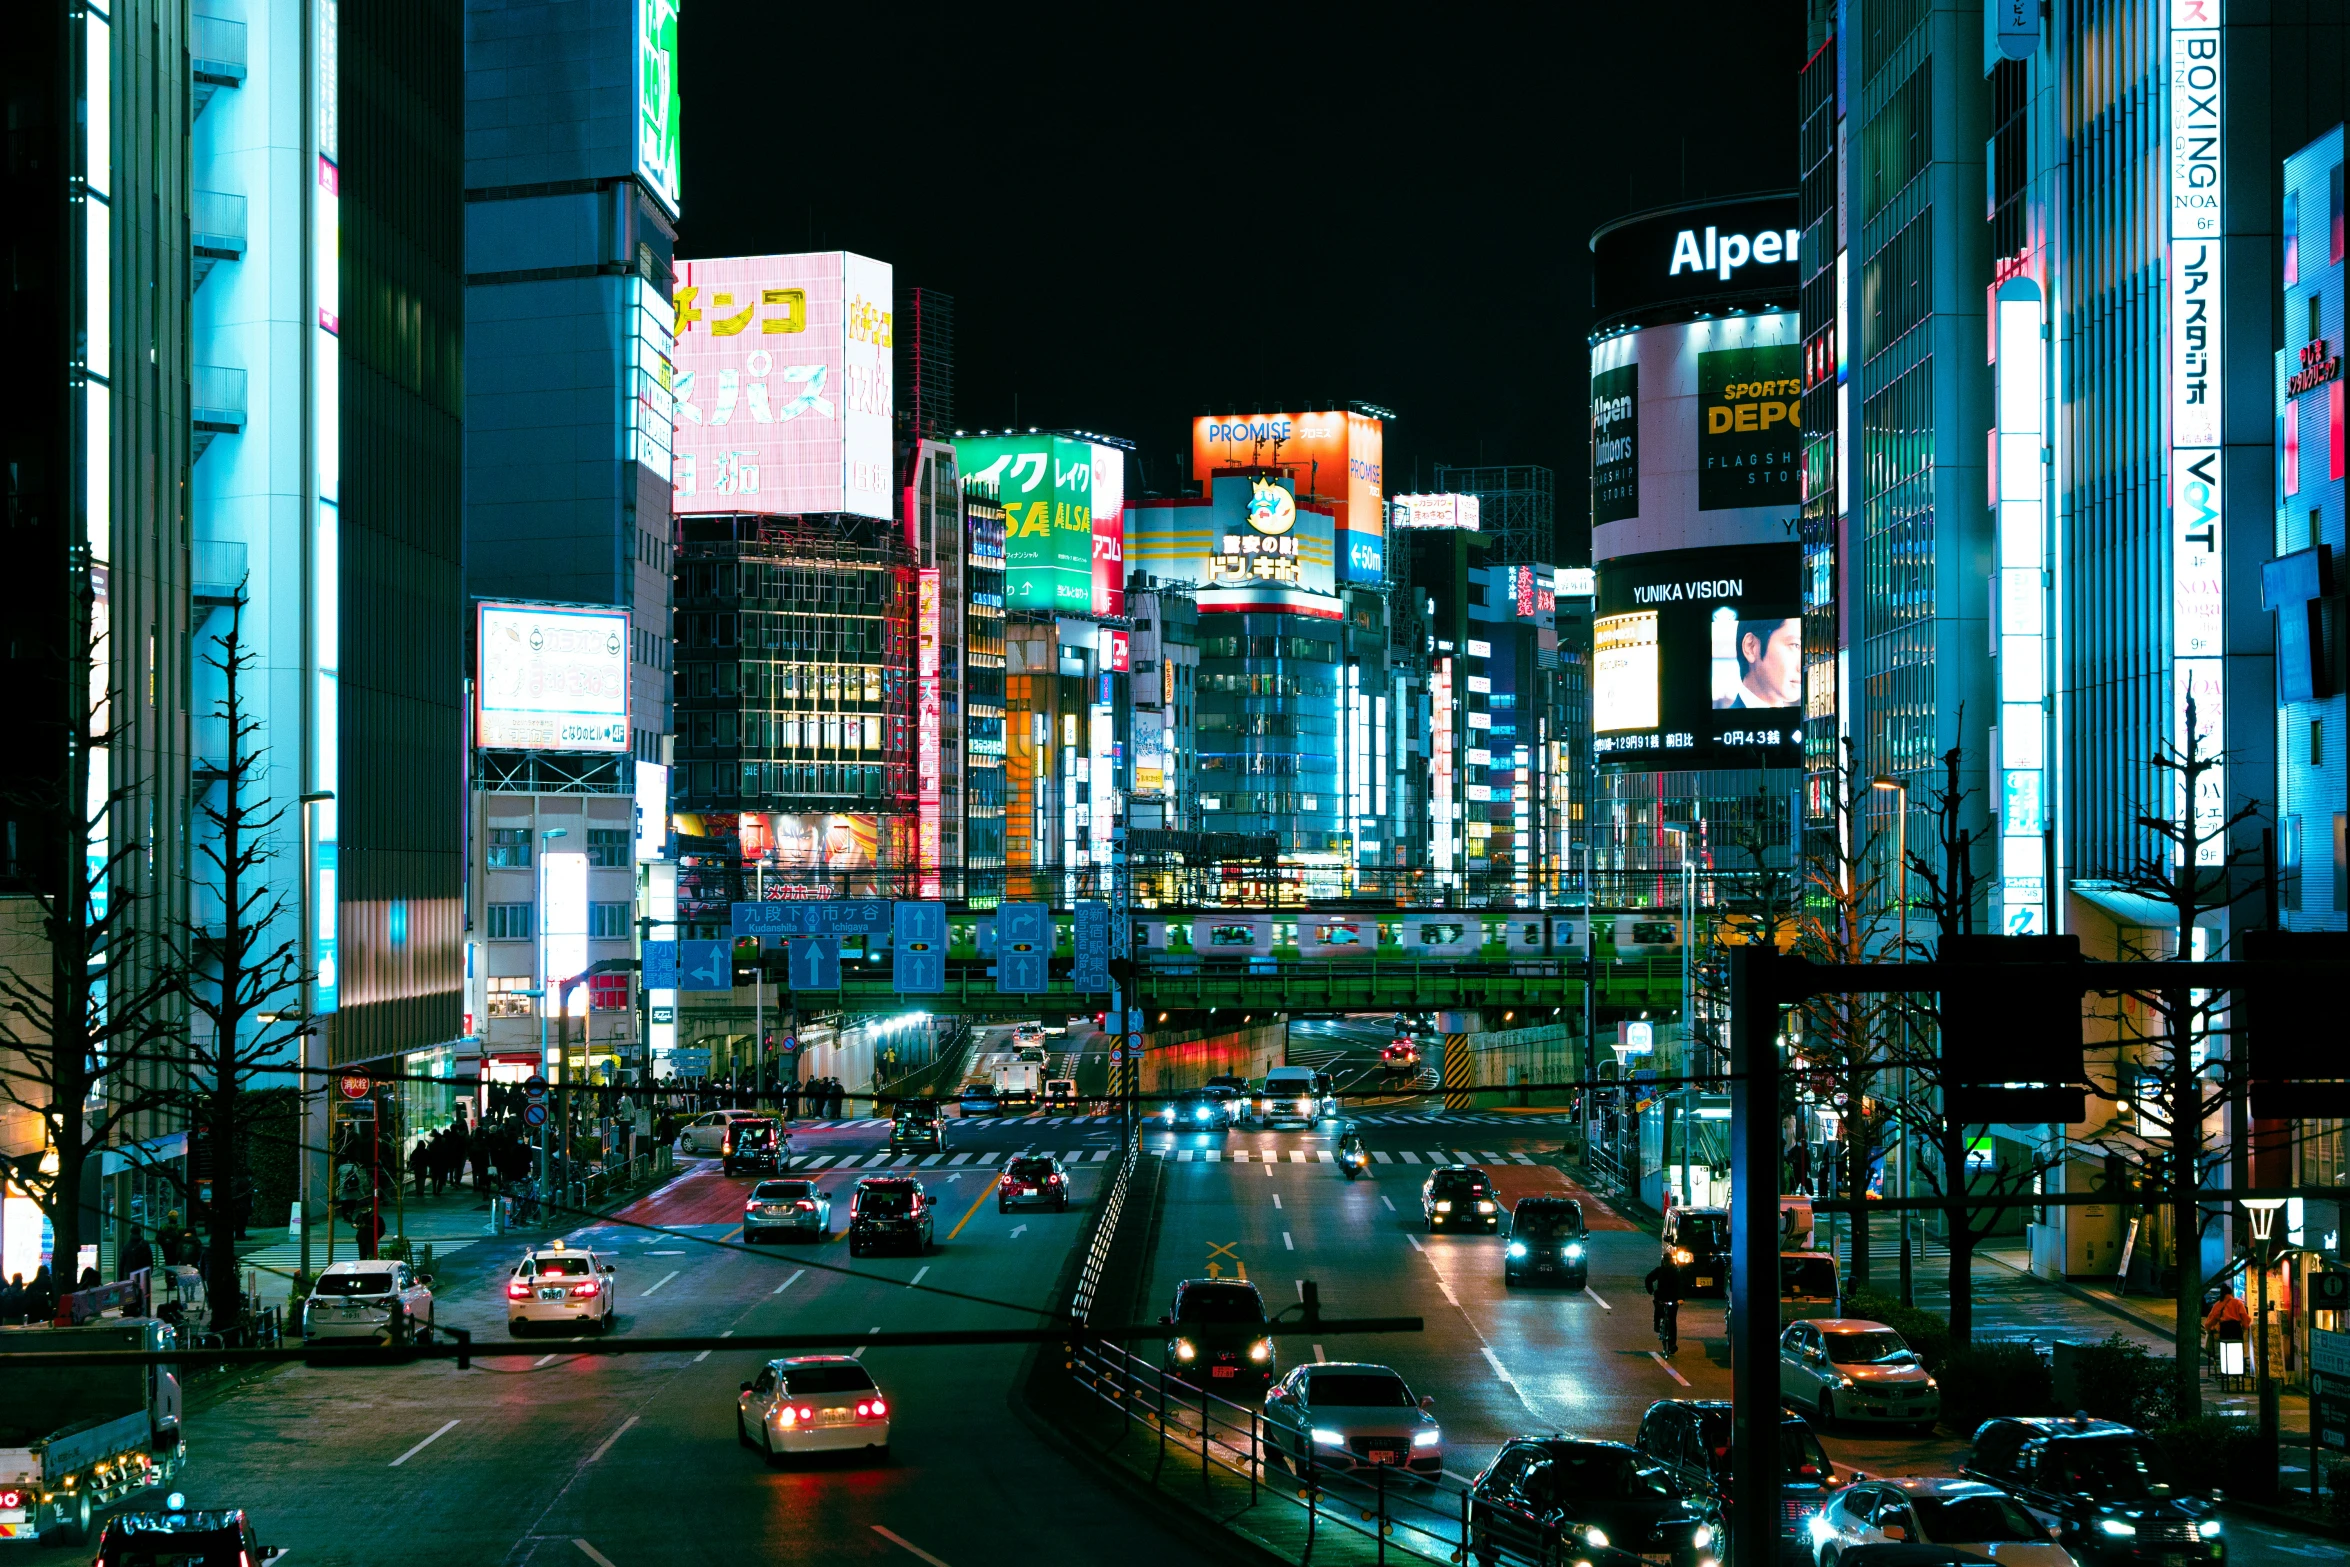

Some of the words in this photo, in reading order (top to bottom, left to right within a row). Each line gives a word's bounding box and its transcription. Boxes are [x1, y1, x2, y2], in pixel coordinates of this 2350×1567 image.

[2174, 38, 2185, 130] FITNESS
[2187, 38, 2218, 189] BOXING
[2174, 135, 2185, 181] GYM
[2174, 194, 2219, 209] NOA
[2197, 216, 2215, 231] 6F
[2184, 244, 2209, 406] ノアスタジオ
[1593, 395, 1632, 434] Alpen
[1209, 421, 1292, 443] PROMISE
[1300, 427, 1332, 439] プロミス
[1595, 433, 1632, 468] Outdoors
[962, 452, 1049, 493] イク
[1054, 457, 1091, 493] レイク
[1350, 458, 1381, 485] PROMISE
[1054, 501, 1091, 534] ALSA
[1092, 534, 1122, 563] アコム
[1361, 544, 1382, 572] 50m
[972, 592, 1003, 609] CASINO
[1633, 583, 1683, 604] YUNIKA
[1685, 578, 1743, 600] VISION
[544, 627, 608, 655] カラオケ
[2190, 637, 2208, 650] 9F
[528, 657, 623, 699] まねきねこ
[561, 724, 604, 742] となりのビル
[612, 724, 625, 743] 4F
[1665, 732, 1694, 748] 前日比
[2200, 848, 2217, 861] 9F
[766, 884, 832, 901] メガホール
[744, 905, 803, 922] 九段下
[808, 913, 816, 924] 4
[748, 923, 798, 934] Kudanshita
[832, 922, 869, 933] Ichigaya
[1077, 909, 1089, 950] Shinjuku
[1089, 907, 1105, 987] 新宿駅東口
[657, 943, 674, 986] 小滝橋
[343, 1078, 368, 1090] 消火栓
